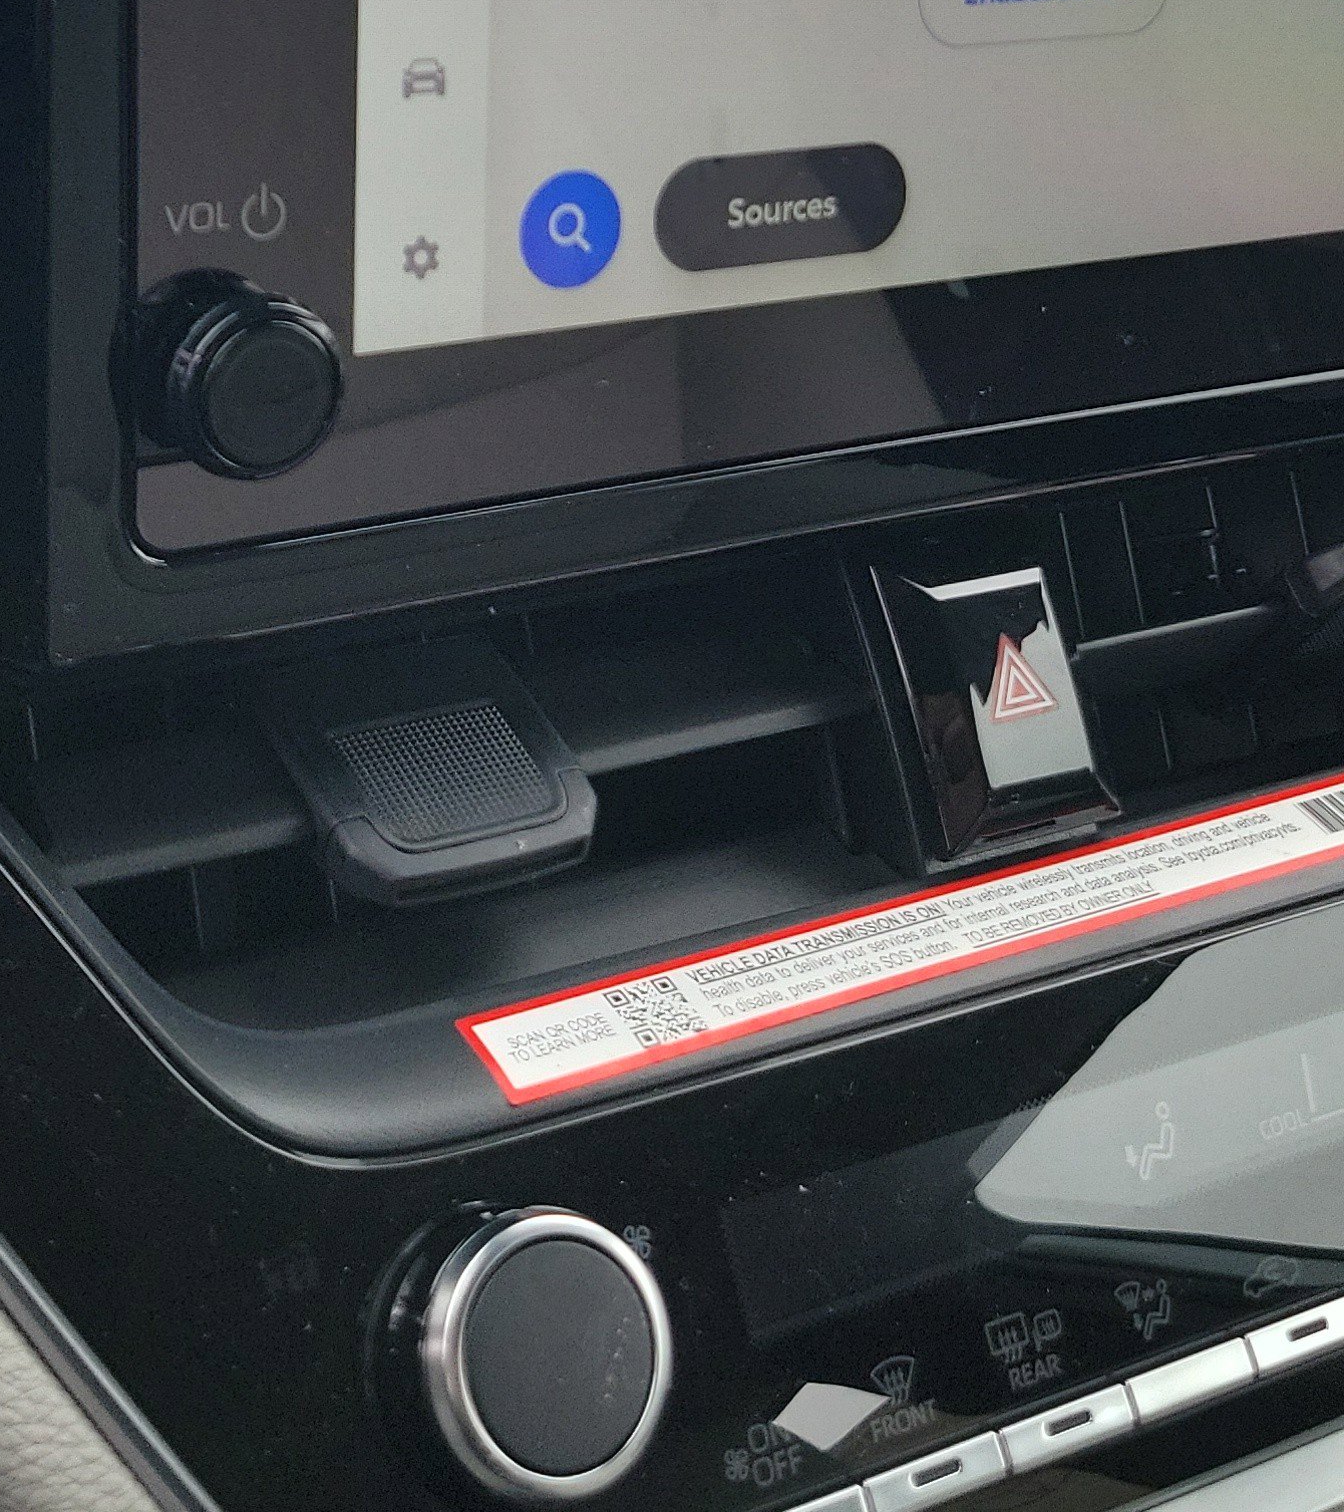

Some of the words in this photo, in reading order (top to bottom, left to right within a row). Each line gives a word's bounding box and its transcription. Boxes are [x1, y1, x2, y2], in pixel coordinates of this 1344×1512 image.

[164, 201, 230, 236] VOL
[727, 196, 839, 229] Sources
[684, 954, 755, 984] VEHICLE
[750, 943, 797, 965] DATA
[790, 913, 903, 954] TRANSMISSION
[897, 908, 919, 923] IS
[912, 901, 946, 919] ON!
[942, 894, 976, 911] Your
[969, 882, 1019, 904] vehicle
[1012, 866, 1077, 894] wirelessly
[1069, 851, 1127, 875] transmits
[1120, 838, 1175, 862] location,
[1167, 827, 1213, 849] driving
[1204, 821, 1233, 837] and
[1226, 810, 1272, 830] vehicle
[698, 978, 747, 1001] health
[741, 969, 777, 989] data
[774, 965, 794, 979] to
[790, 952, 839, 975] deliver
[836, 945, 871, 964] your
[864, 928, 922, 953] services
[915, 921, 946, 938] and
[941, 915, 966, 931] for
[959, 902, 1011, 925] internal
[1005, 888, 1063, 912] research
[1057, 881, 1086, 897] and
[1080, 873, 1113, 890] data
[1106, 859, 1165, 885] analysis.
[1156, 852, 1186, 869] See
[711, 1000, 737, 1018] To
[730, 985, 792, 1015] disable,
[785, 976, 830, 999] press
[821, 958, 884, 986] vehicle's
[878, 950, 915, 969] SOS
[909, 936, 959, 960] button.
[961, 929, 986, 945] TO
[980, 924, 1005, 939] BE
[998, 906, 1064, 934] REMOVED
[1057, 901, 1081, 916] BY
[1075, 888, 1126, 911] OWNER
[1119, 879, 1157, 898] ONLY
[505, 1028, 547, 1050] SCAN
[543, 1022, 571, 1039] QR
[565, 1011, 608, 1032] CODE
[507, 1047, 533, 1064] TO
[527, 1034, 578, 1058] LEARN
[572, 1022, 618, 1045] MORE
[1258, 1108, 1311, 1141] COOL
[1007, 1353, 1063, 1391] REAR
[869, 1397, 938, 1443] FRONT
[752, 1443, 804, 1487] OFF
